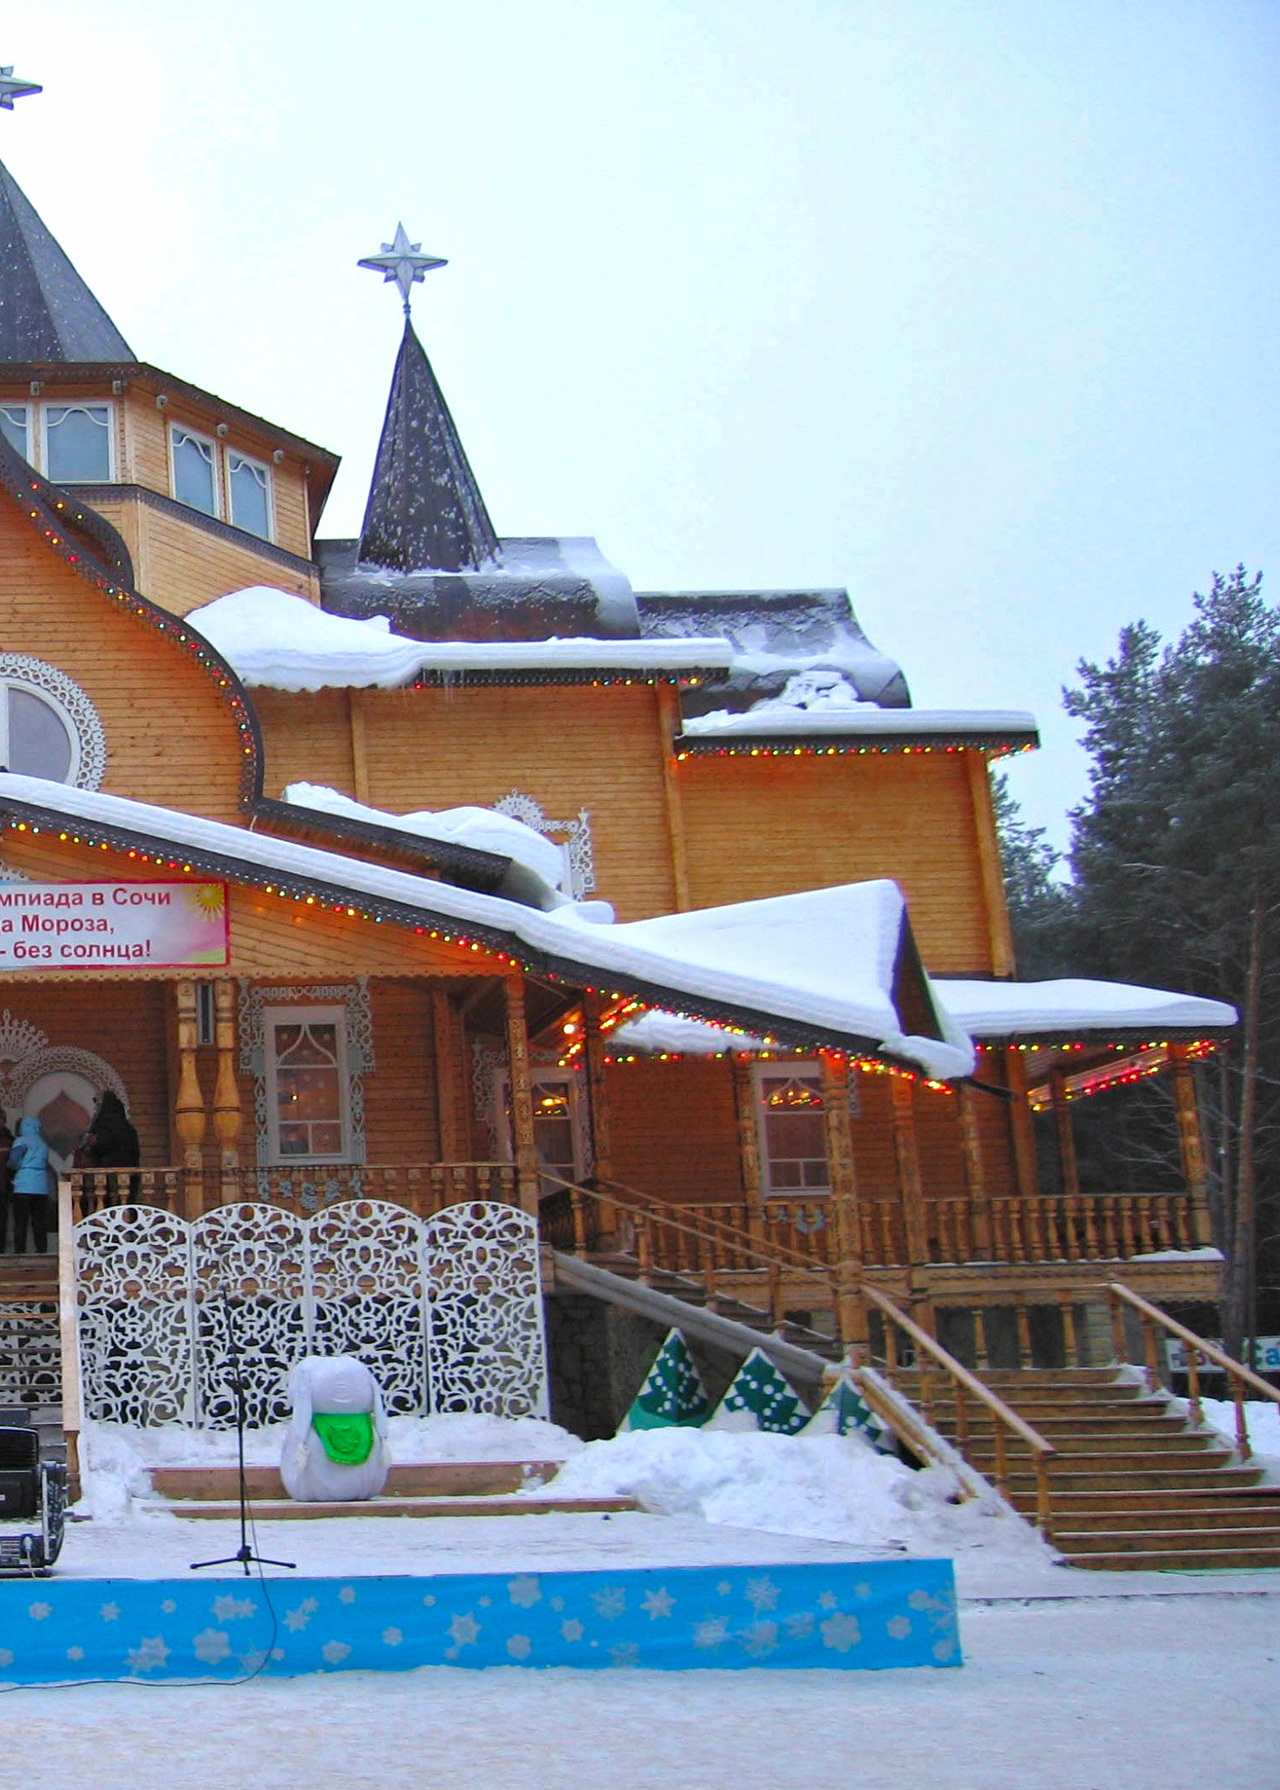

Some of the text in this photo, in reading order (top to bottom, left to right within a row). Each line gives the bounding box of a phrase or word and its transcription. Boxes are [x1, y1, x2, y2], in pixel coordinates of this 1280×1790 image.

[91, 892, 105, 906] в
[112, 887, 171, 906] Сочи
[21, 914, 115, 936] Мороза,
[13, 940, 53, 959] без
[59, 939, 151, 961] солнца!
